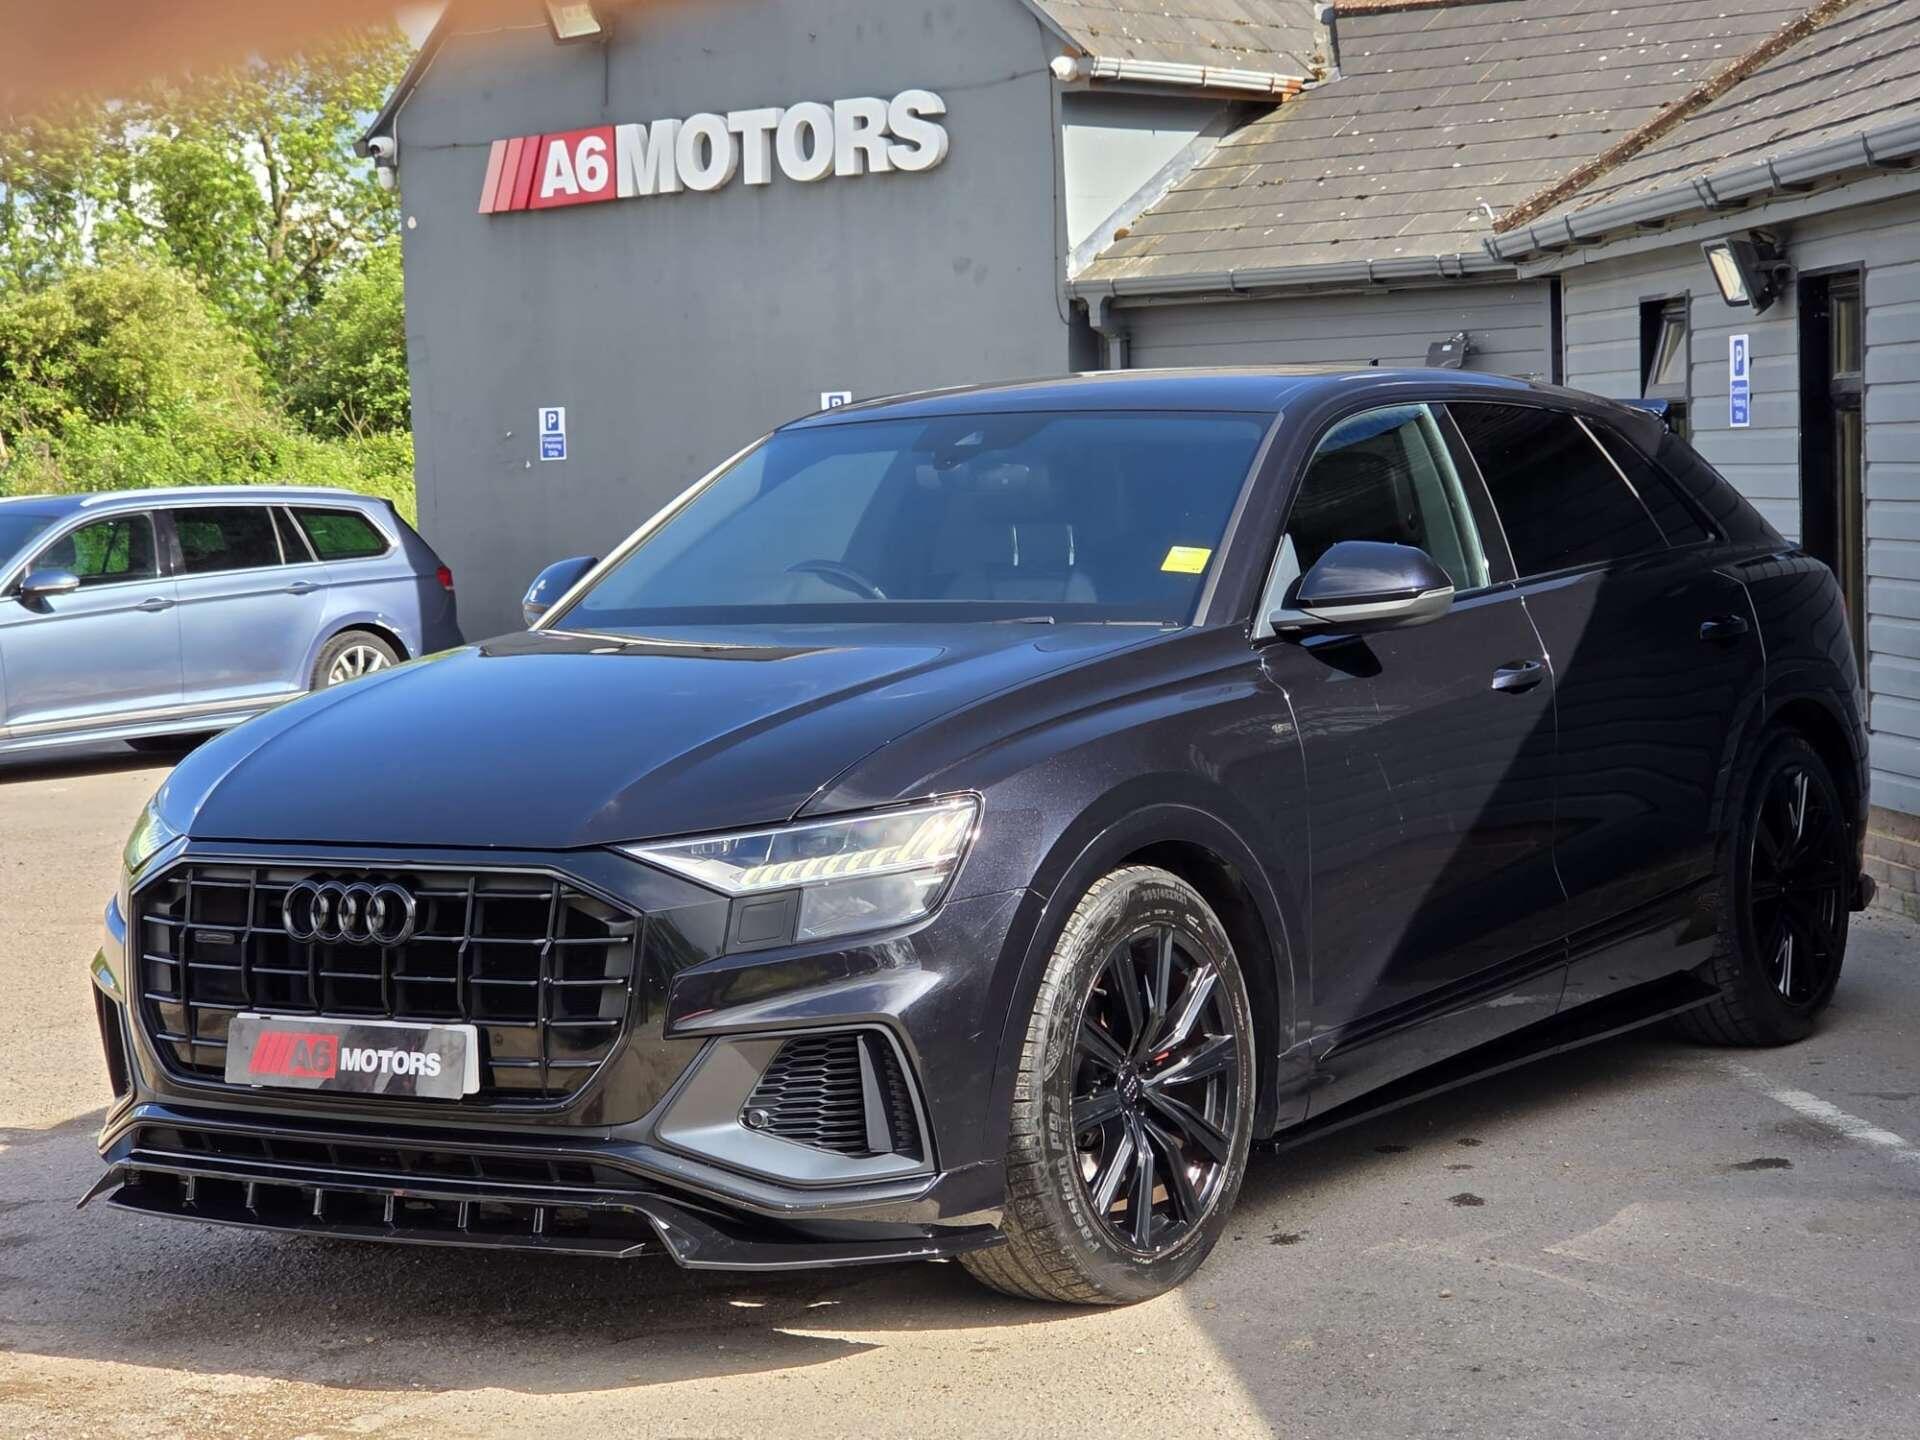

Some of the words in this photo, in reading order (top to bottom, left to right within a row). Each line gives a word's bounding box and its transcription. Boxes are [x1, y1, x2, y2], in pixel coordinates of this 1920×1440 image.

[540, 136, 609, 198] A6
[616, 89, 949, 198] MOTORS
[1735, 345, 1743, 371] P
[548, 412, 557, 429] P
[289, 1039, 331, 1073] A6
[340, 1047, 442, 1077] MOTORS
